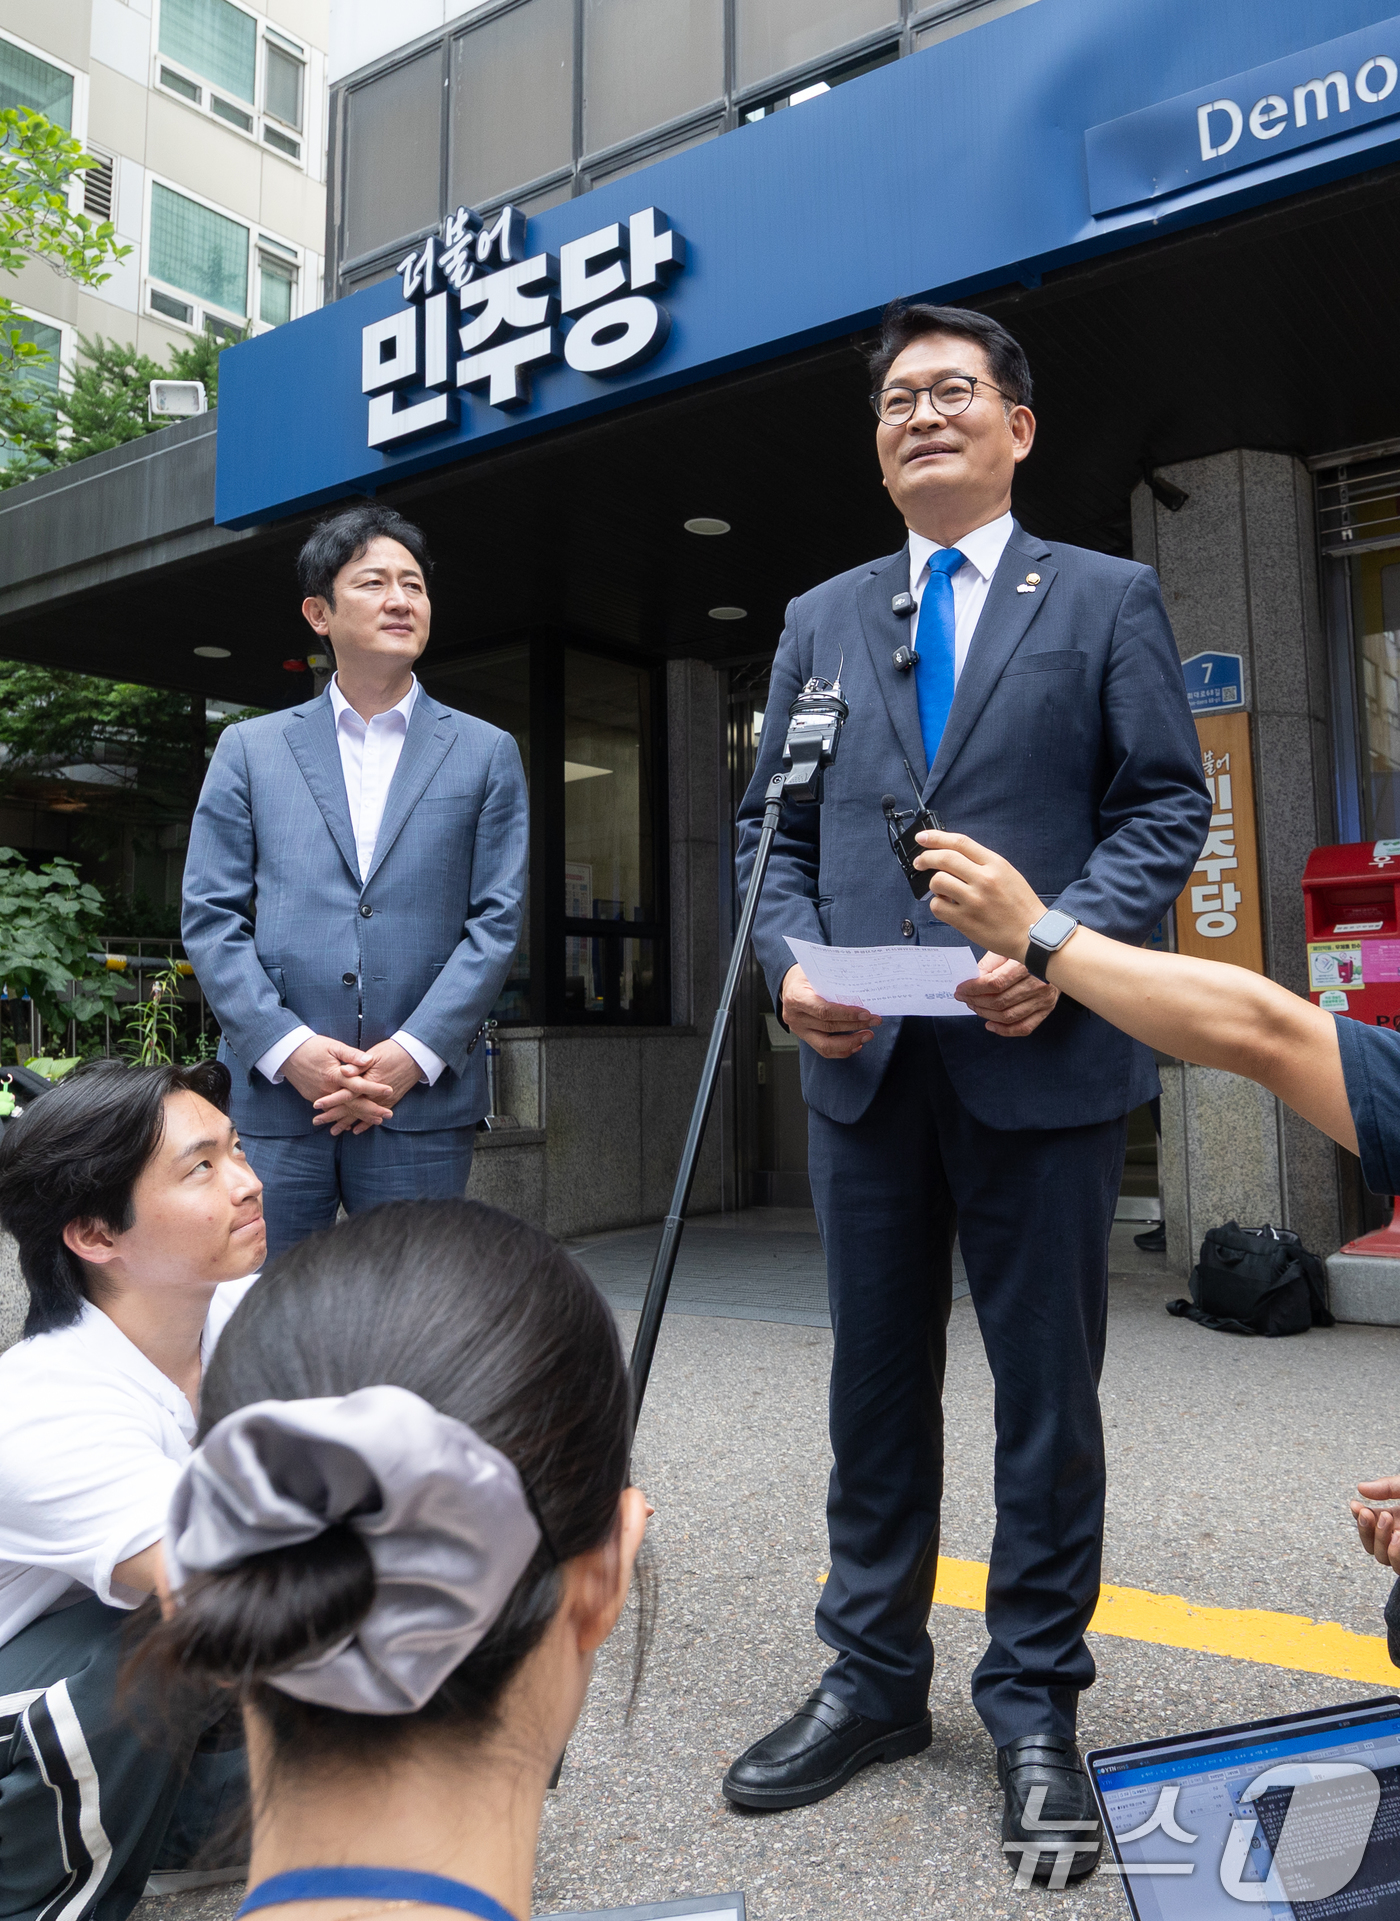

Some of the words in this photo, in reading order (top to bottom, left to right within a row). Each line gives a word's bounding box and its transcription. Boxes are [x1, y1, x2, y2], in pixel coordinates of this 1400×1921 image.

[1197, 55, 1399, 162] Demo
[396, 204, 513, 300] 더불어
[362, 206, 673, 448] 민주당
[1201, 662, 1213, 684] 7
[1203, 750, 1230, 776] 불어
